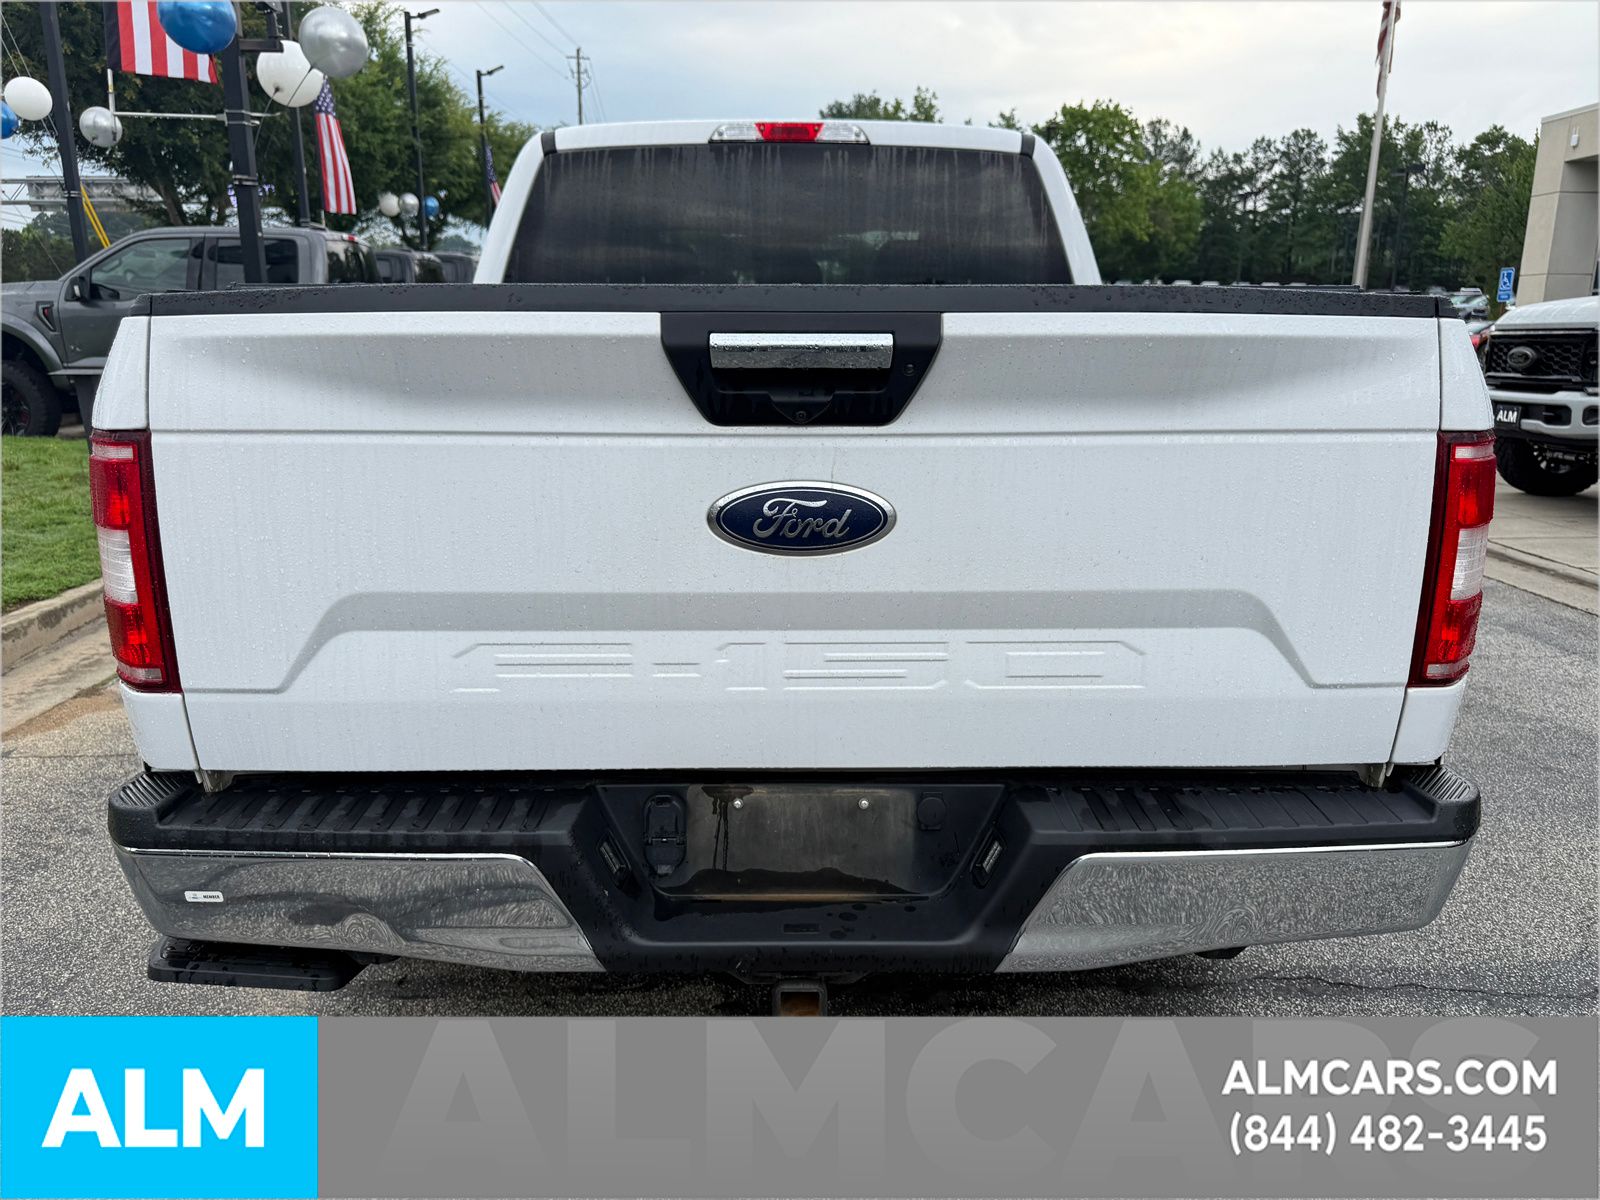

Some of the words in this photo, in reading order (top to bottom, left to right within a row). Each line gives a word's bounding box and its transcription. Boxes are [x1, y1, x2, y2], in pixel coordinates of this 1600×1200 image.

[1496, 409, 1518, 423] ALM
[752, 497, 855, 538] Ford
[452, 641, 1146, 692] F-150
